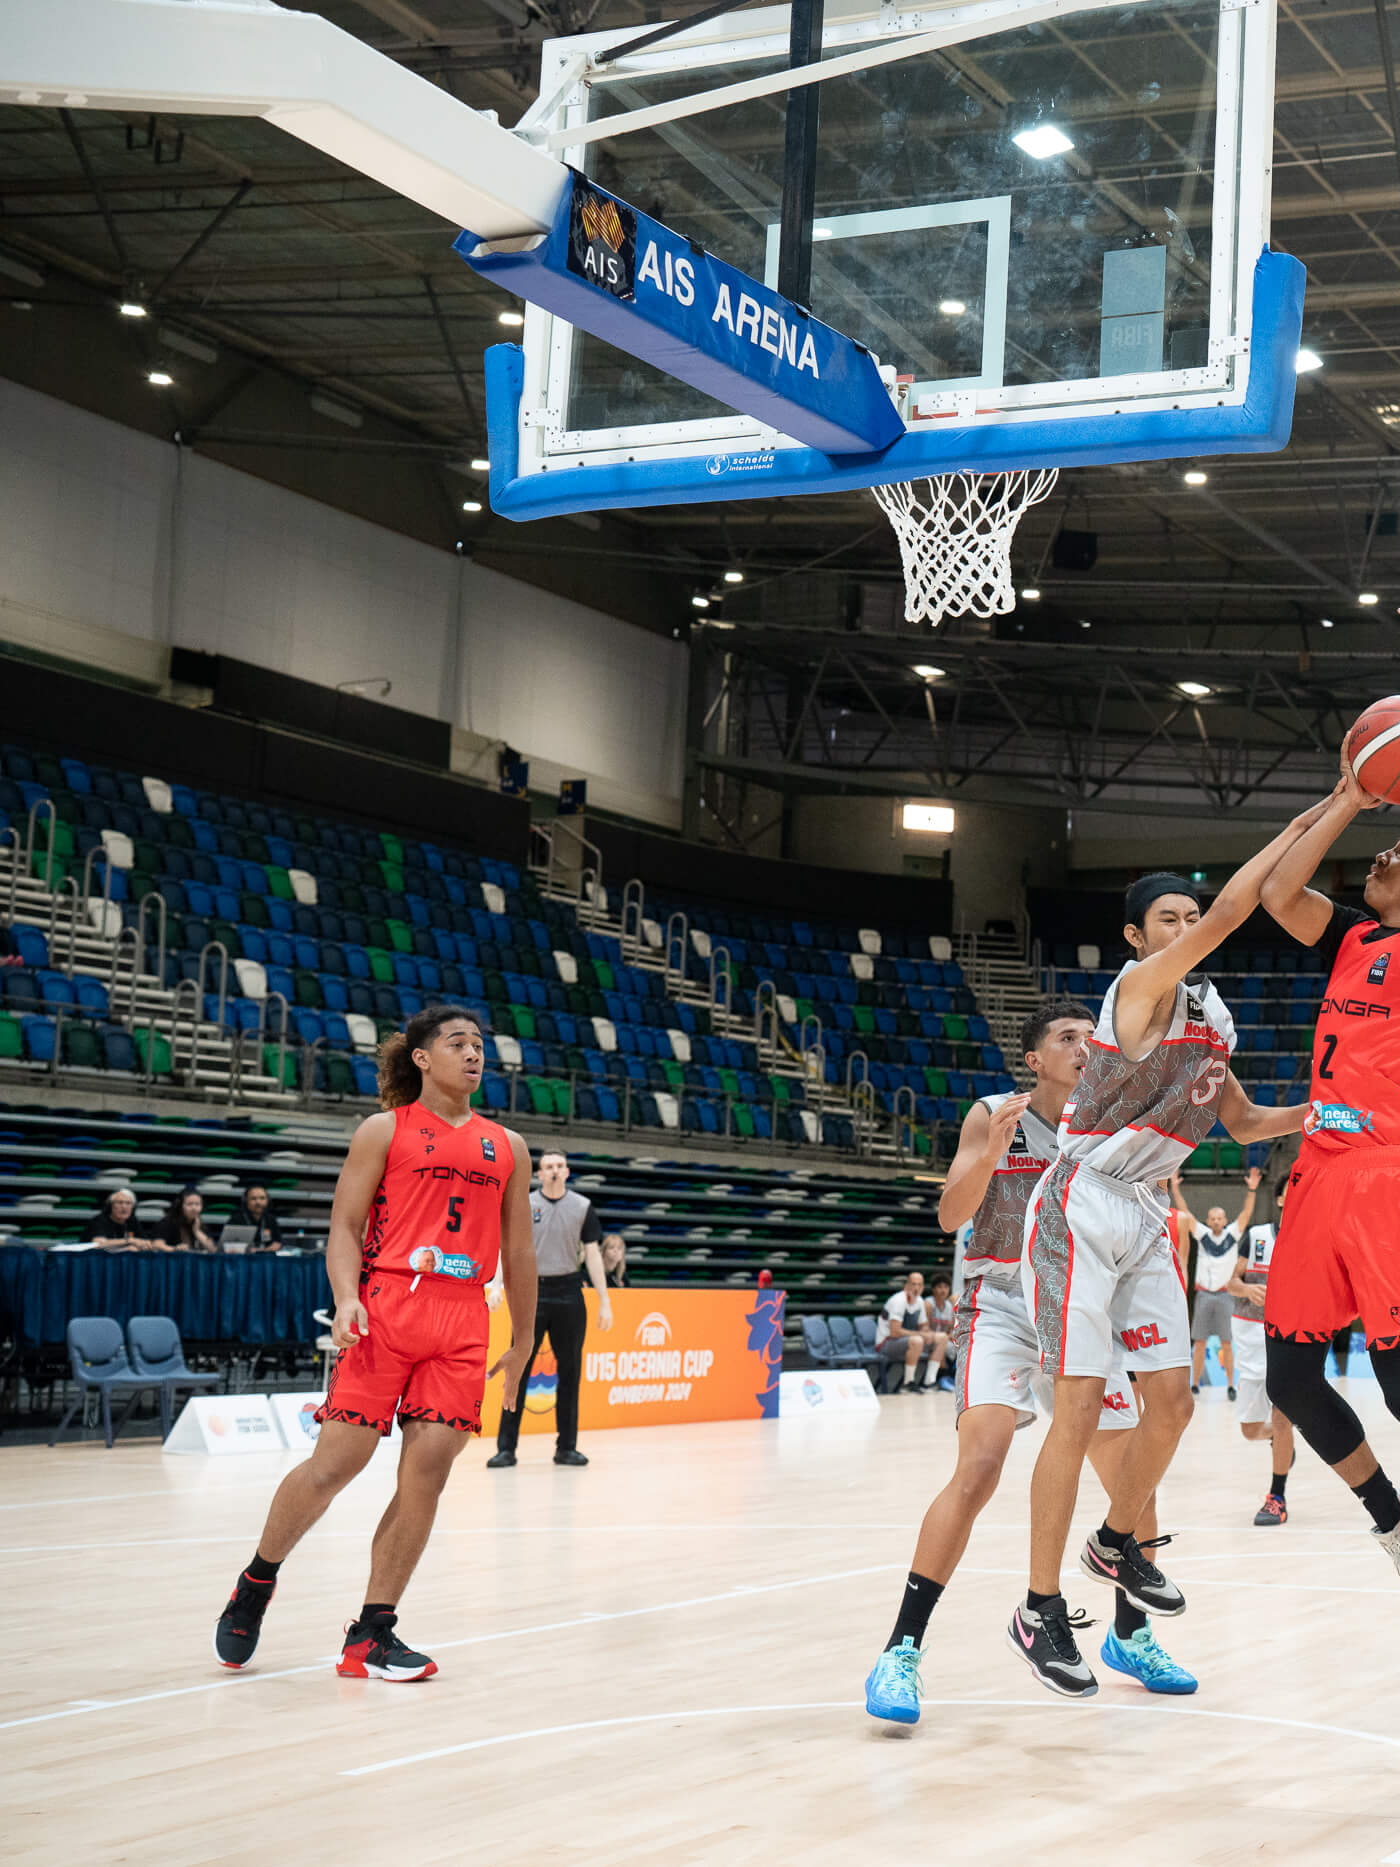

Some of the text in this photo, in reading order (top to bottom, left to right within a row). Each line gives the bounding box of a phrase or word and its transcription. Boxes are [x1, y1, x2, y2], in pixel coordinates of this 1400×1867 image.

[584, 245, 618, 284] AIS
[638, 240, 819, 379] AIS ARENA
[732, 454, 775, 465] schelde
[1319, 998, 1391, 1020] ONGA
[1319, 1034, 1338, 1080] 2
[412, 1166, 500, 1190] TONGA
[446, 1196, 464, 1232] 5
[641, 1326, 666, 1346] FIBA
[1121, 1323, 1168, 1352] NCL
[586, 1350, 714, 1382] U15 OCEANIA CUP
[608, 1383, 692, 1406] CANBERRA 2024
